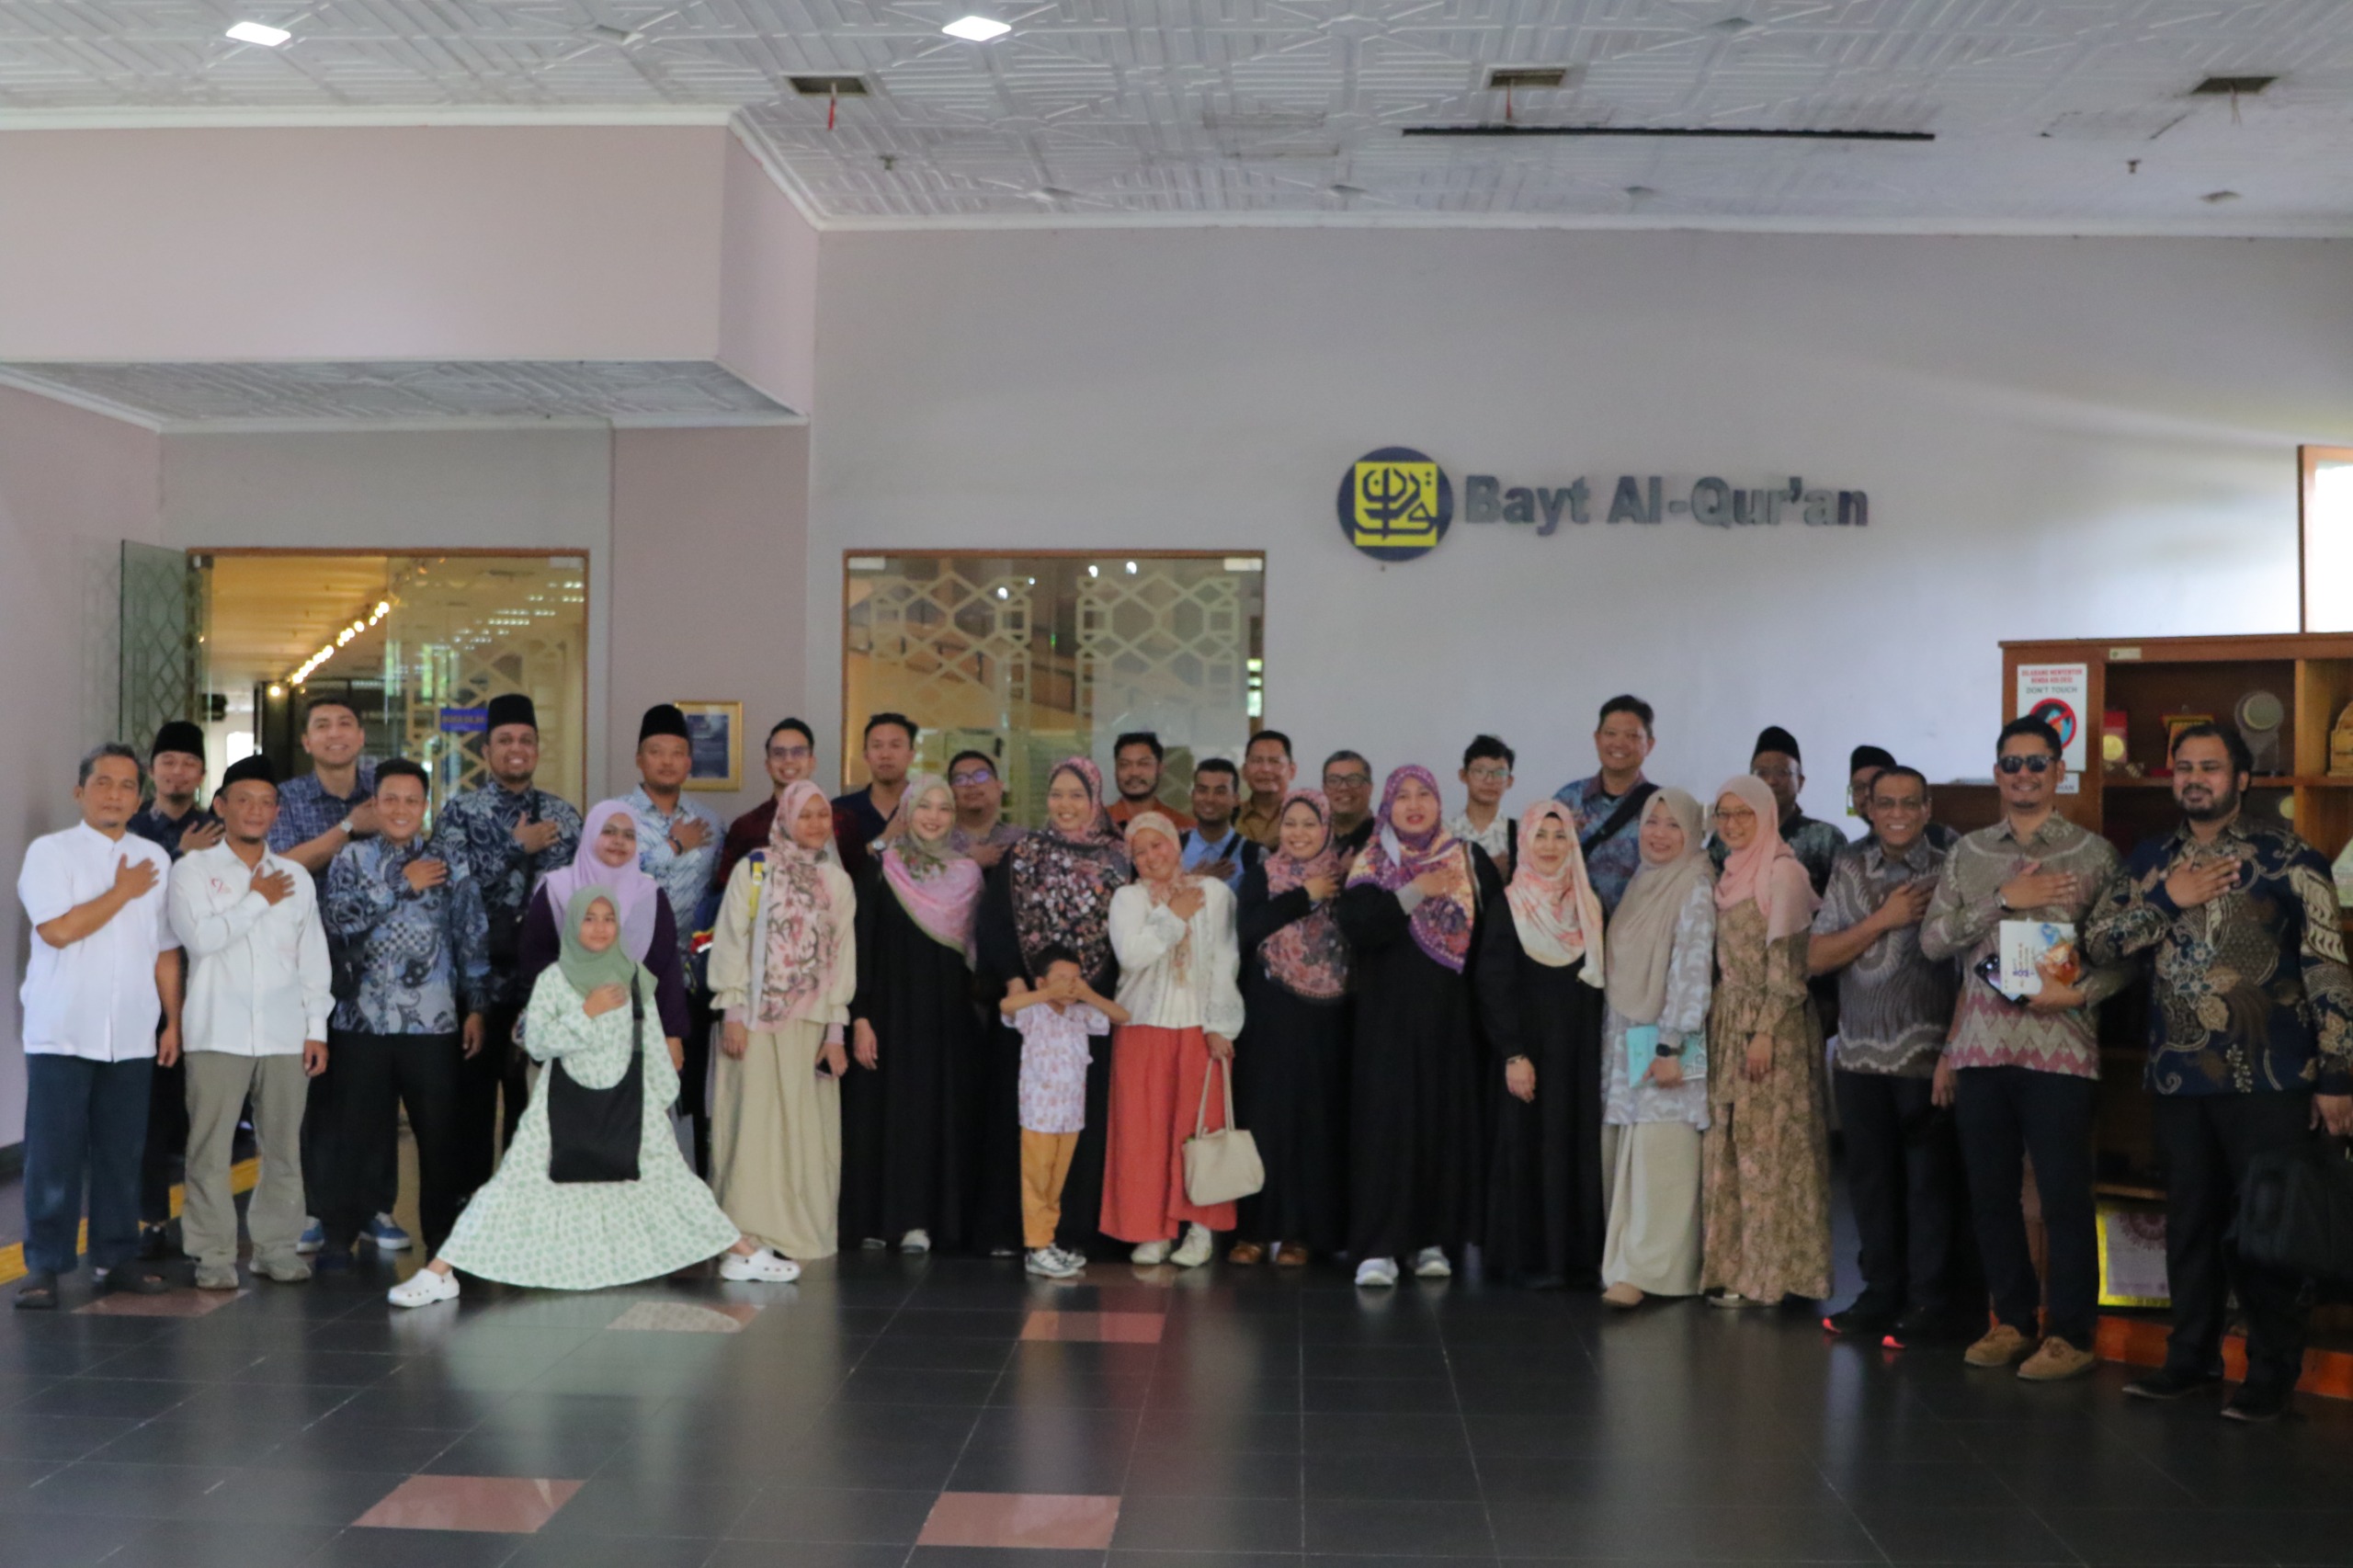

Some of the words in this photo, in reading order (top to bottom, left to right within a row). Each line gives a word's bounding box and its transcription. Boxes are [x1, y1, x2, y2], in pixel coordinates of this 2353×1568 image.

[1463, 474, 1591, 537] Bayt
[1606, 475, 1870, 529] Al-Qur'an
[2026, 686, 2049, 694] DON'T
